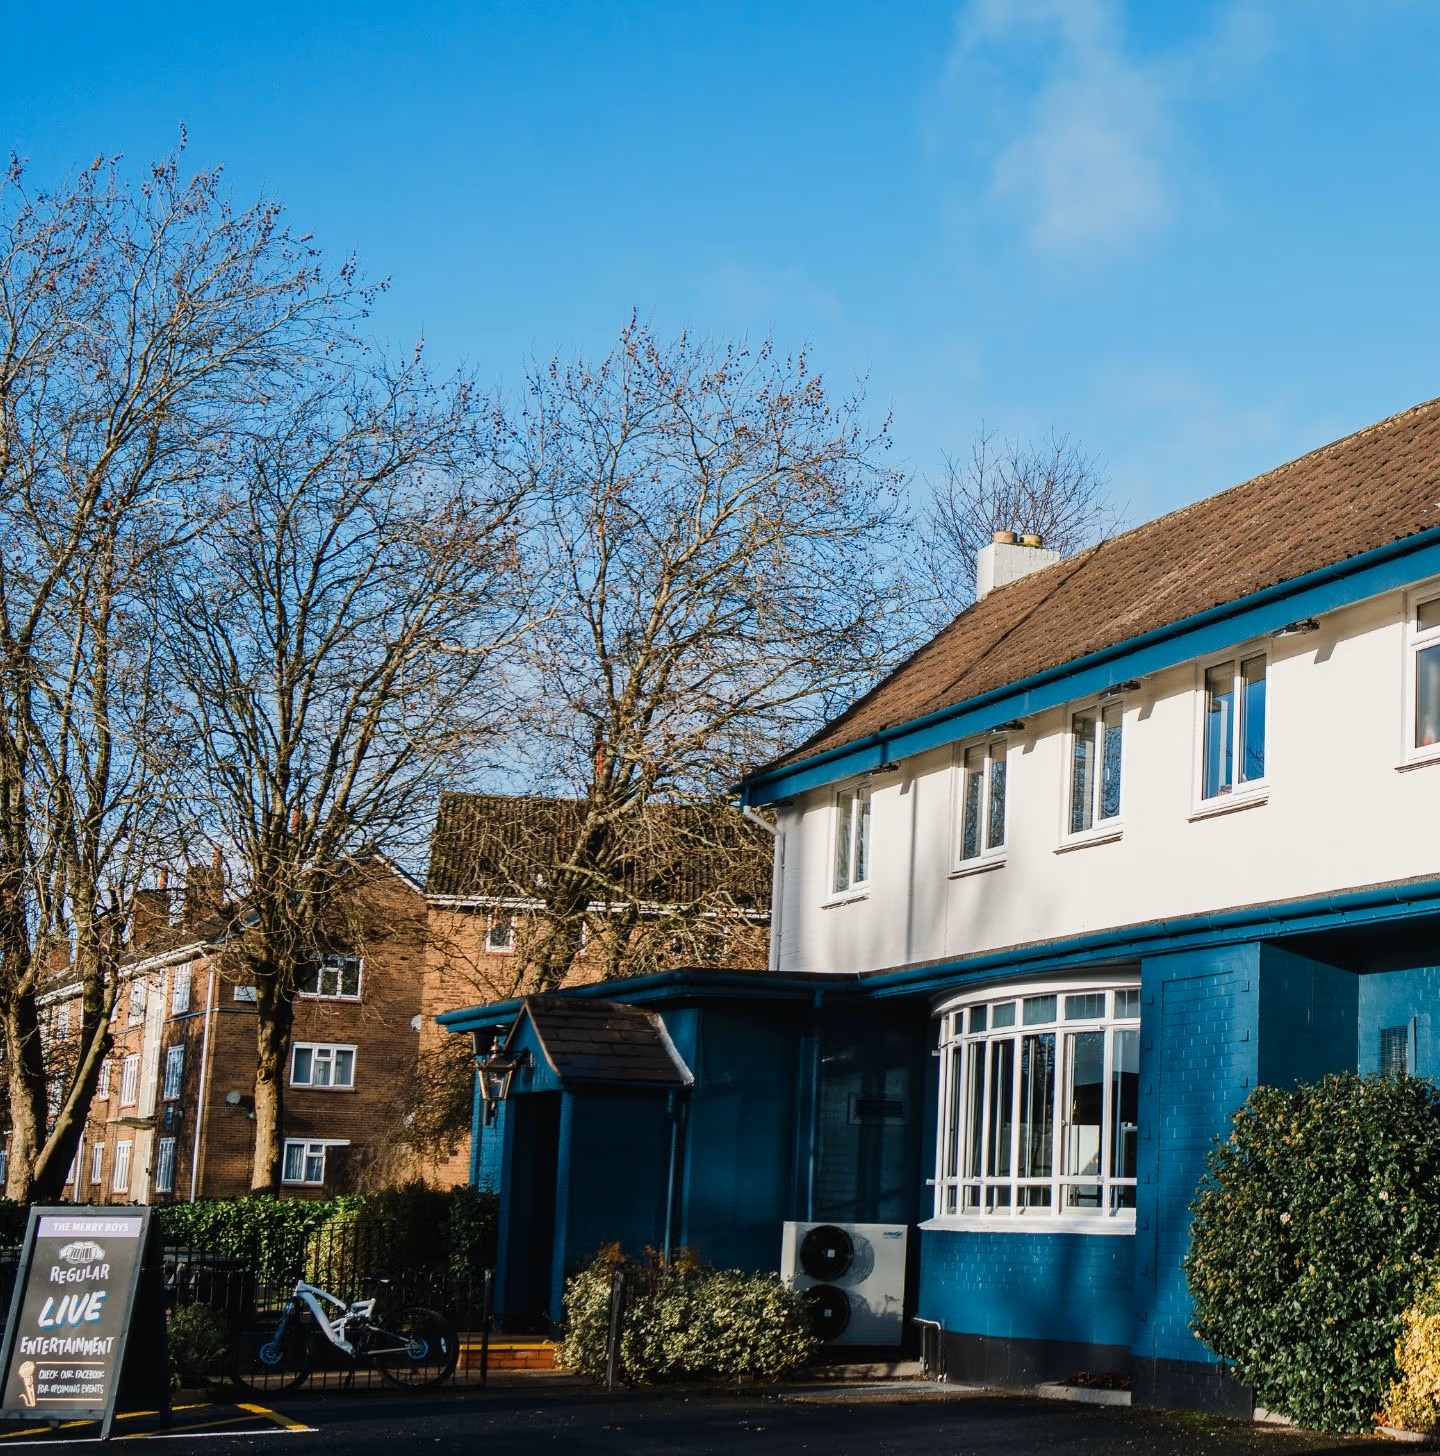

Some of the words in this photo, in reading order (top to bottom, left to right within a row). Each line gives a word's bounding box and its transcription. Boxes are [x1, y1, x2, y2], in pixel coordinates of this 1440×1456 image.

[53, 1222, 70, 1232] THE
[72, 1222, 104, 1232] MERRY
[104, 1222, 129, 1232] BOYS
[49, 1263, 110, 1284] REGULAR
[38, 1290, 107, 1329] LIVE
[20, 1336, 115, 1356] ENTERTAINMENT
[38, 1369, 58, 1379] CHECK
[60, 1369, 75, 1379] OUR
[75, 1369, 105, 1379] FACEBOOK
[37, 1384, 49, 1394] FOR
[50, 1384, 81, 1394] UPCOMING
[81, 1384, 104, 1394] EVENTS
